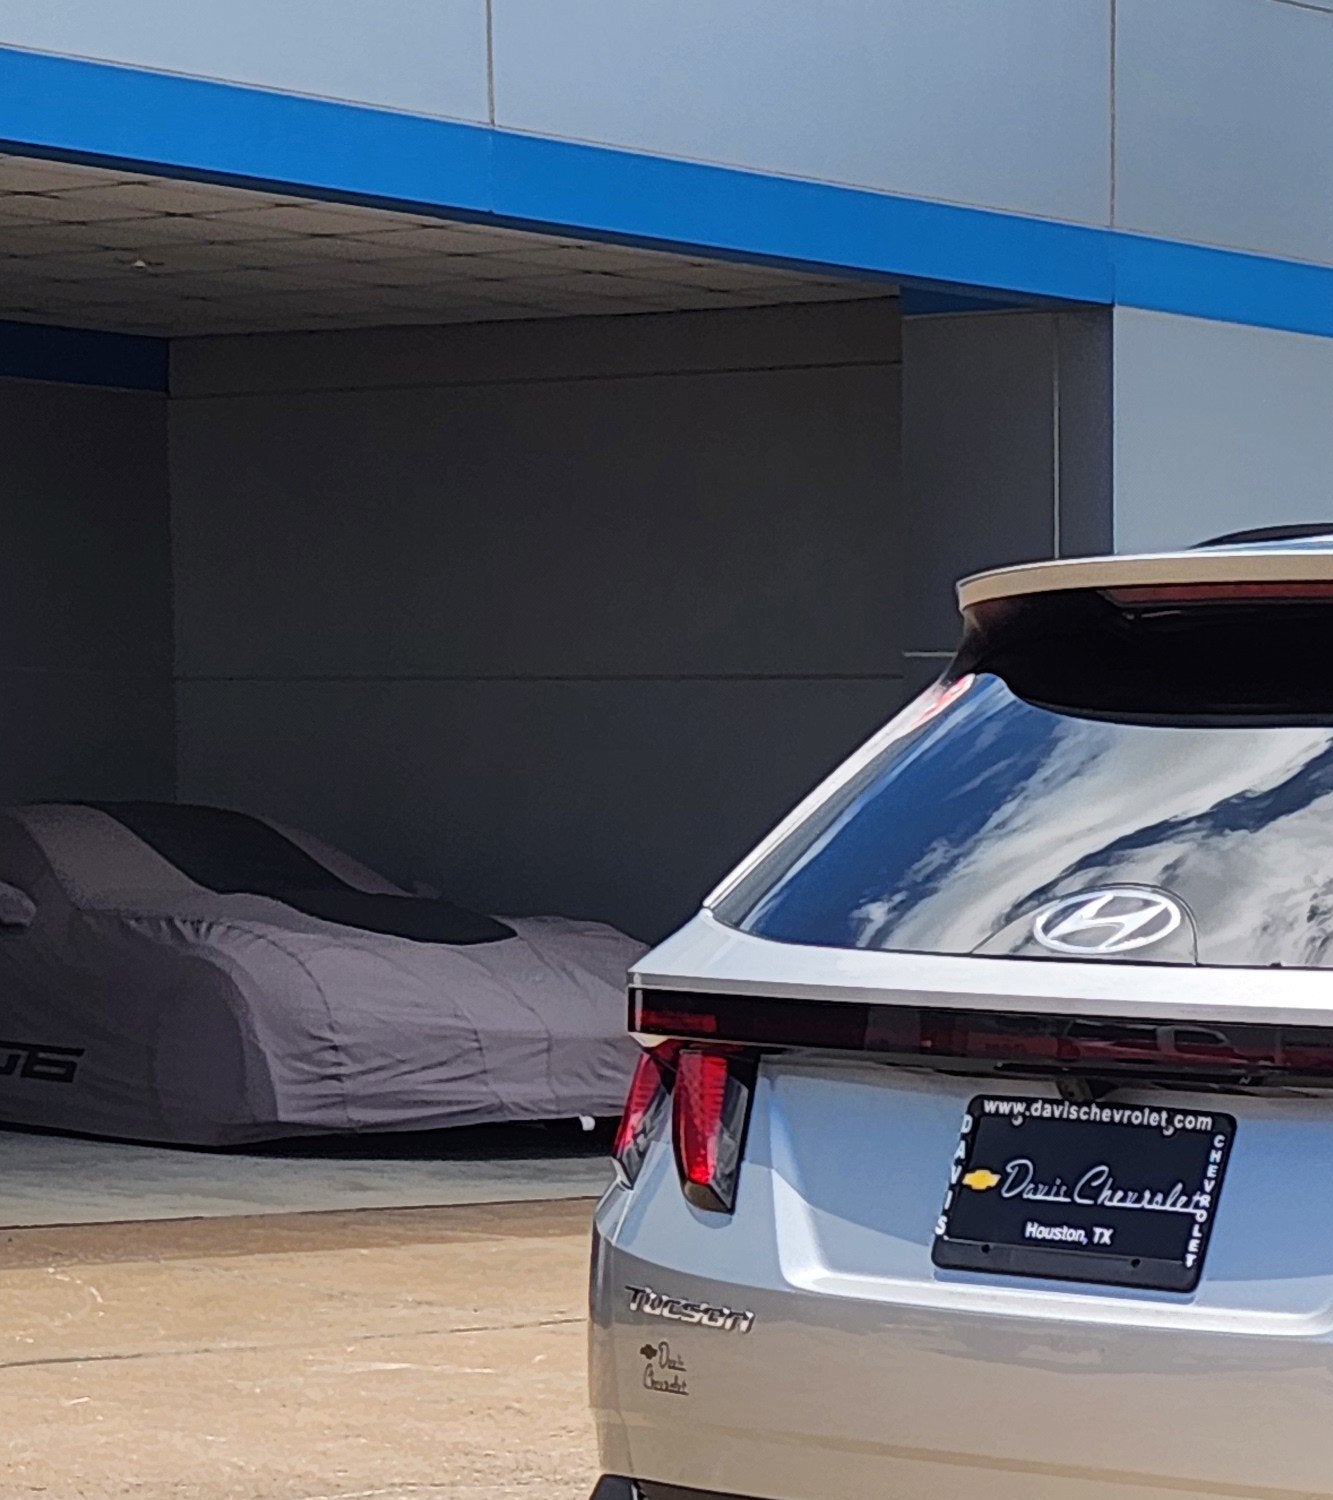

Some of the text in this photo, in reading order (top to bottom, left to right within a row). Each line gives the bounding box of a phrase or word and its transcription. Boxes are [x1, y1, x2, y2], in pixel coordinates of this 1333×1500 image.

[983, 1099, 1213, 1132] www.davischevrolet.com
[934, 1114, 972, 1236] DAVIS
[1001, 1158, 1204, 1213] Davis Chevrolet
[1185, 1134, 1226, 1268] CHEVROLET
[1024, 1221, 1114, 1245] Houston, TX
[625, 1285, 756, 1334] TUCSON
